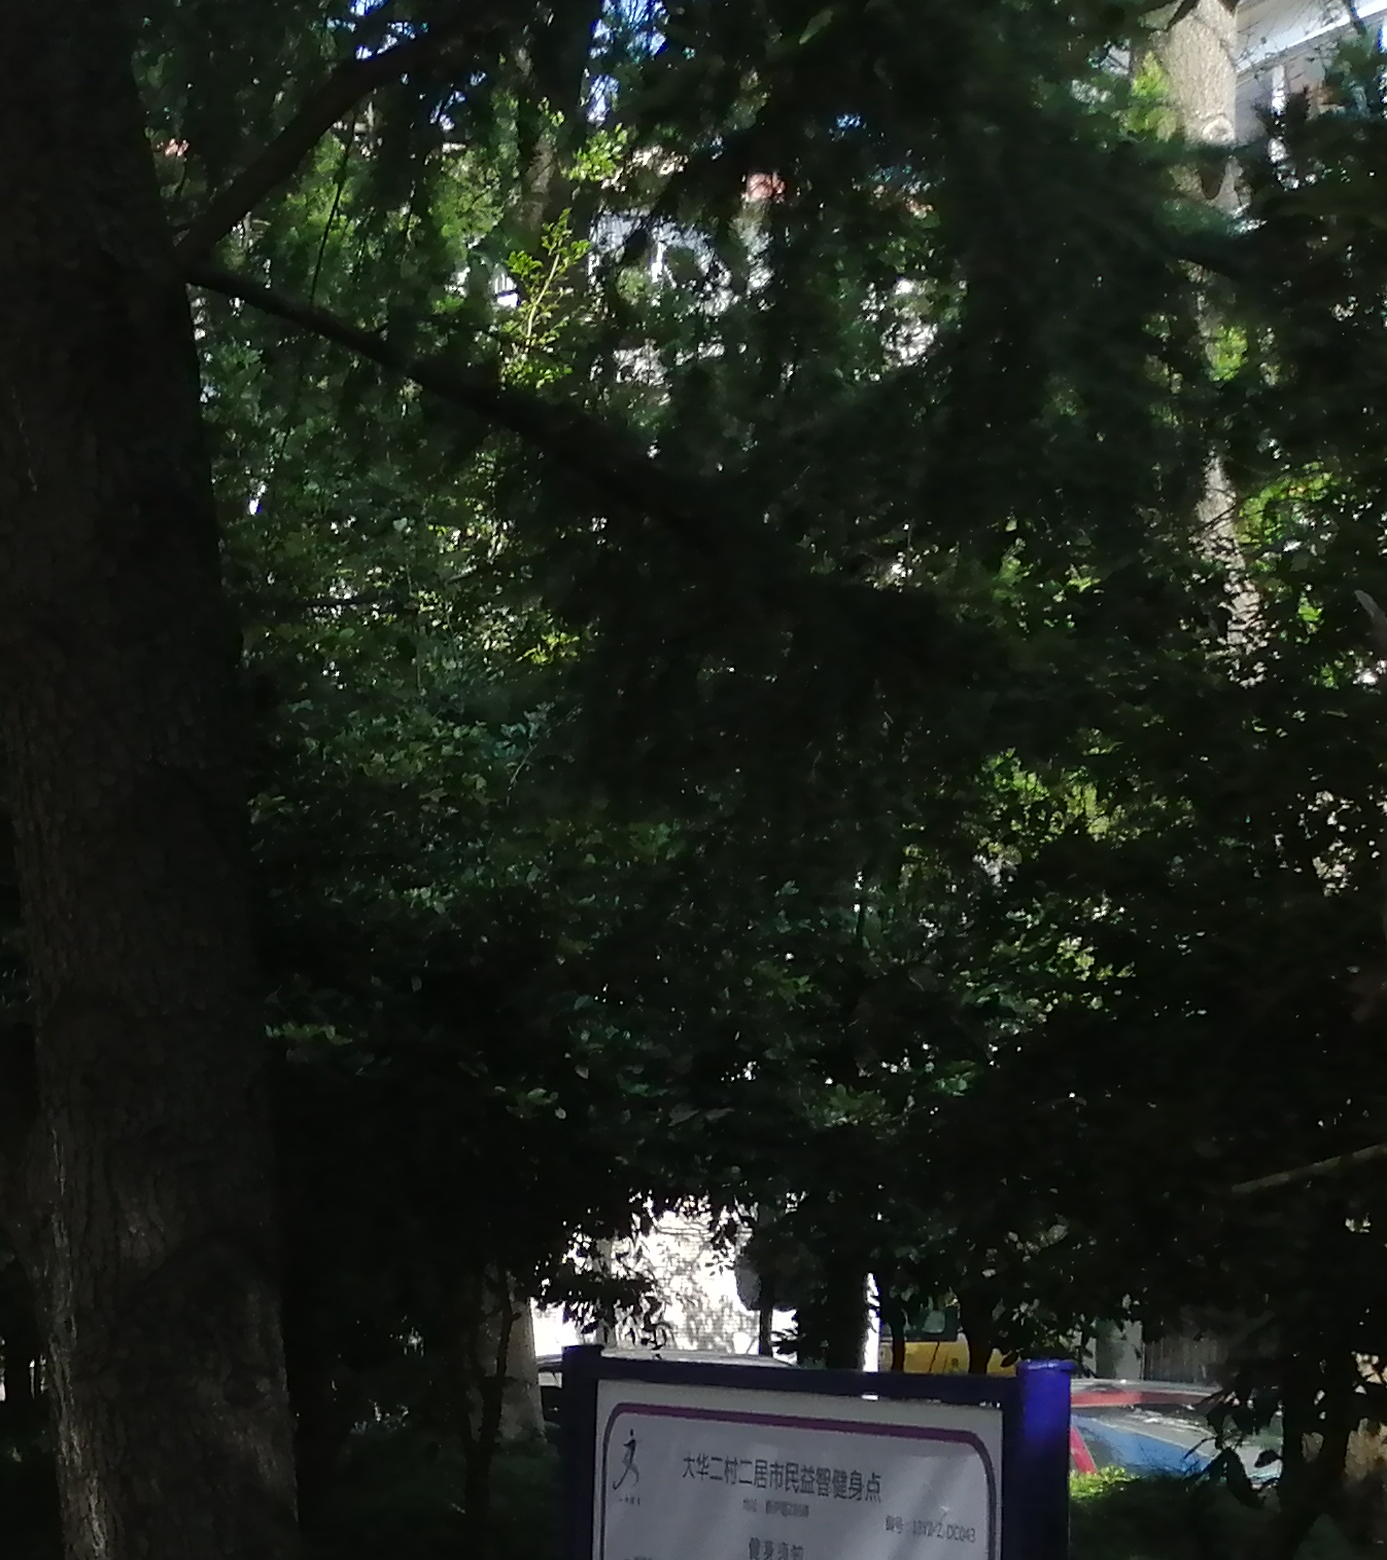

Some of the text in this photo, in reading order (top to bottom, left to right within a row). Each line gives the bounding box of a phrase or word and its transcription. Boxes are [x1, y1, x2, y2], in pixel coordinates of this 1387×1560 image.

[682, 1452, 882, 1503] 大华二村二居市民益智健身点
